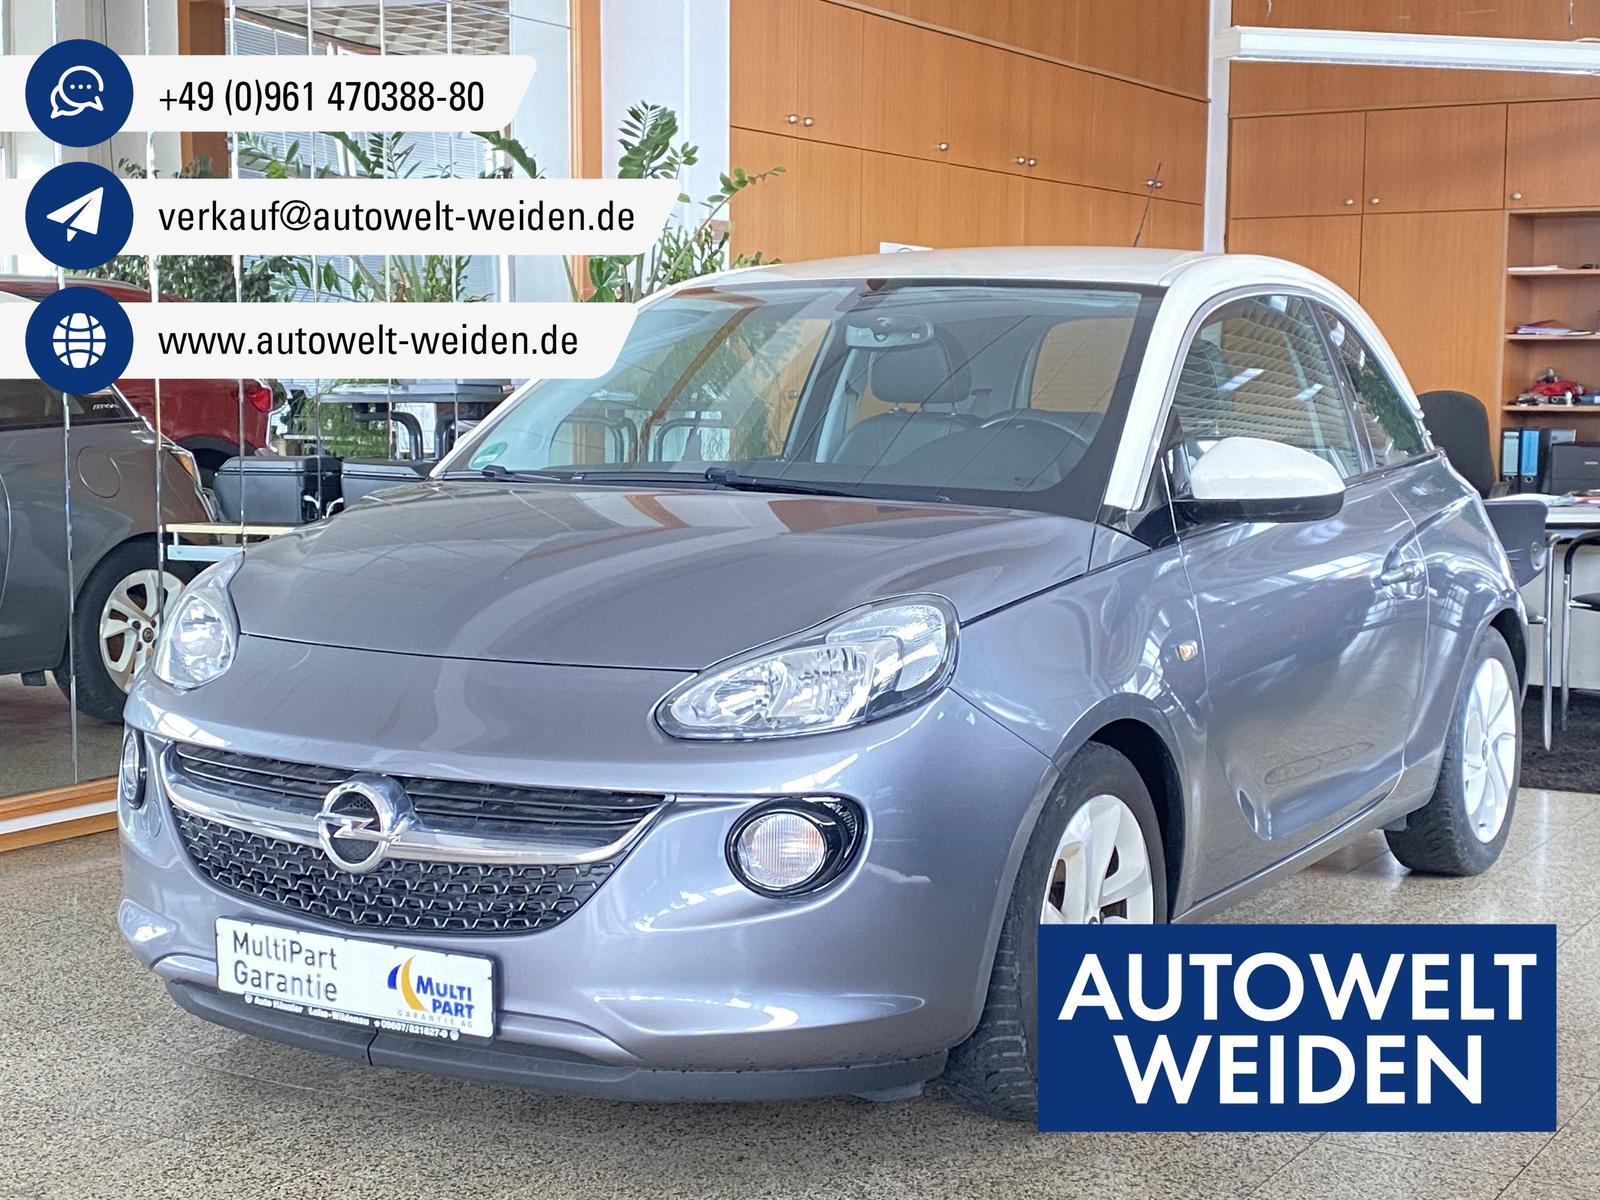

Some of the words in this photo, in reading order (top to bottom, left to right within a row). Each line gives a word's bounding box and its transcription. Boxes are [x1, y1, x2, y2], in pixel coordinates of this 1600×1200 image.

[233, 930, 337, 970] MultiPart
[234, 960, 337, 1002] Garantie
[416, 975, 472, 1002] MULTI
[431, 998, 475, 1019] PART
